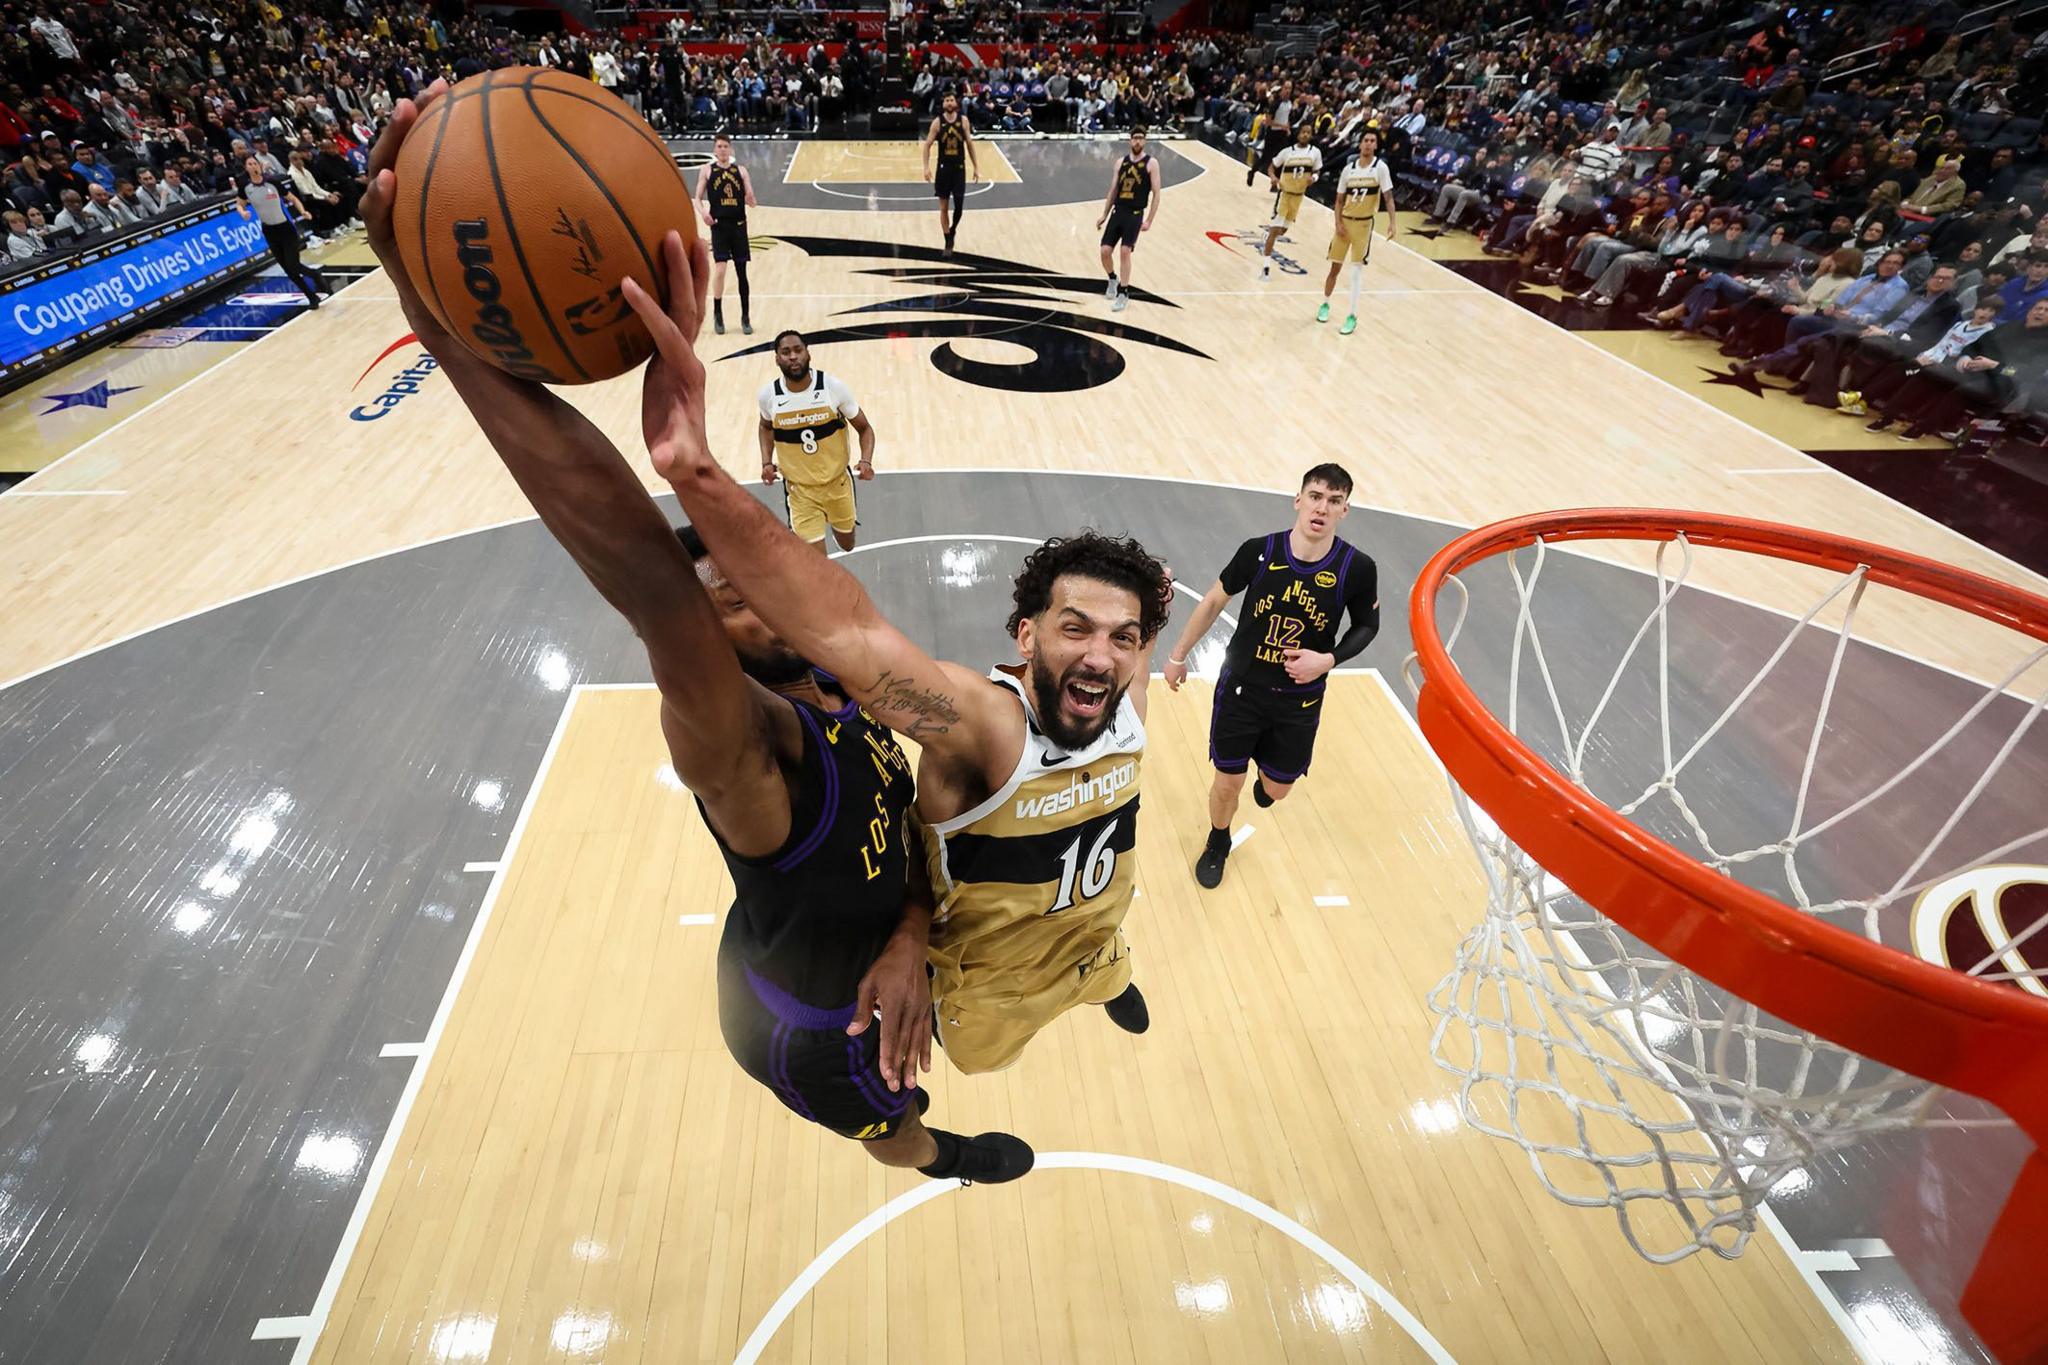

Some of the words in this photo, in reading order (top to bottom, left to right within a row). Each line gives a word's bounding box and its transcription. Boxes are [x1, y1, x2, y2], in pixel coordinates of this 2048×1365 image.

[1351, 188, 1368, 202] 27
[14, 276, 134, 336] Coupang
[122, 250, 190, 293] Drives
[184, 233, 224, 266] U.S.
[217, 219, 262, 252] Expor
[778, 412, 829, 426] washington
[801, 429, 818, 453] 8
[1253, 594, 1275, 617] LOS
[1281, 580, 1328, 632] ANGELES
[1264, 614, 1305, 650] 12
[1256, 646, 1287, 663] LAKE
[1016, 761, 1136, 819] washington
[861, 792, 890, 880] LOS
[1044, 814, 1122, 916] 16
